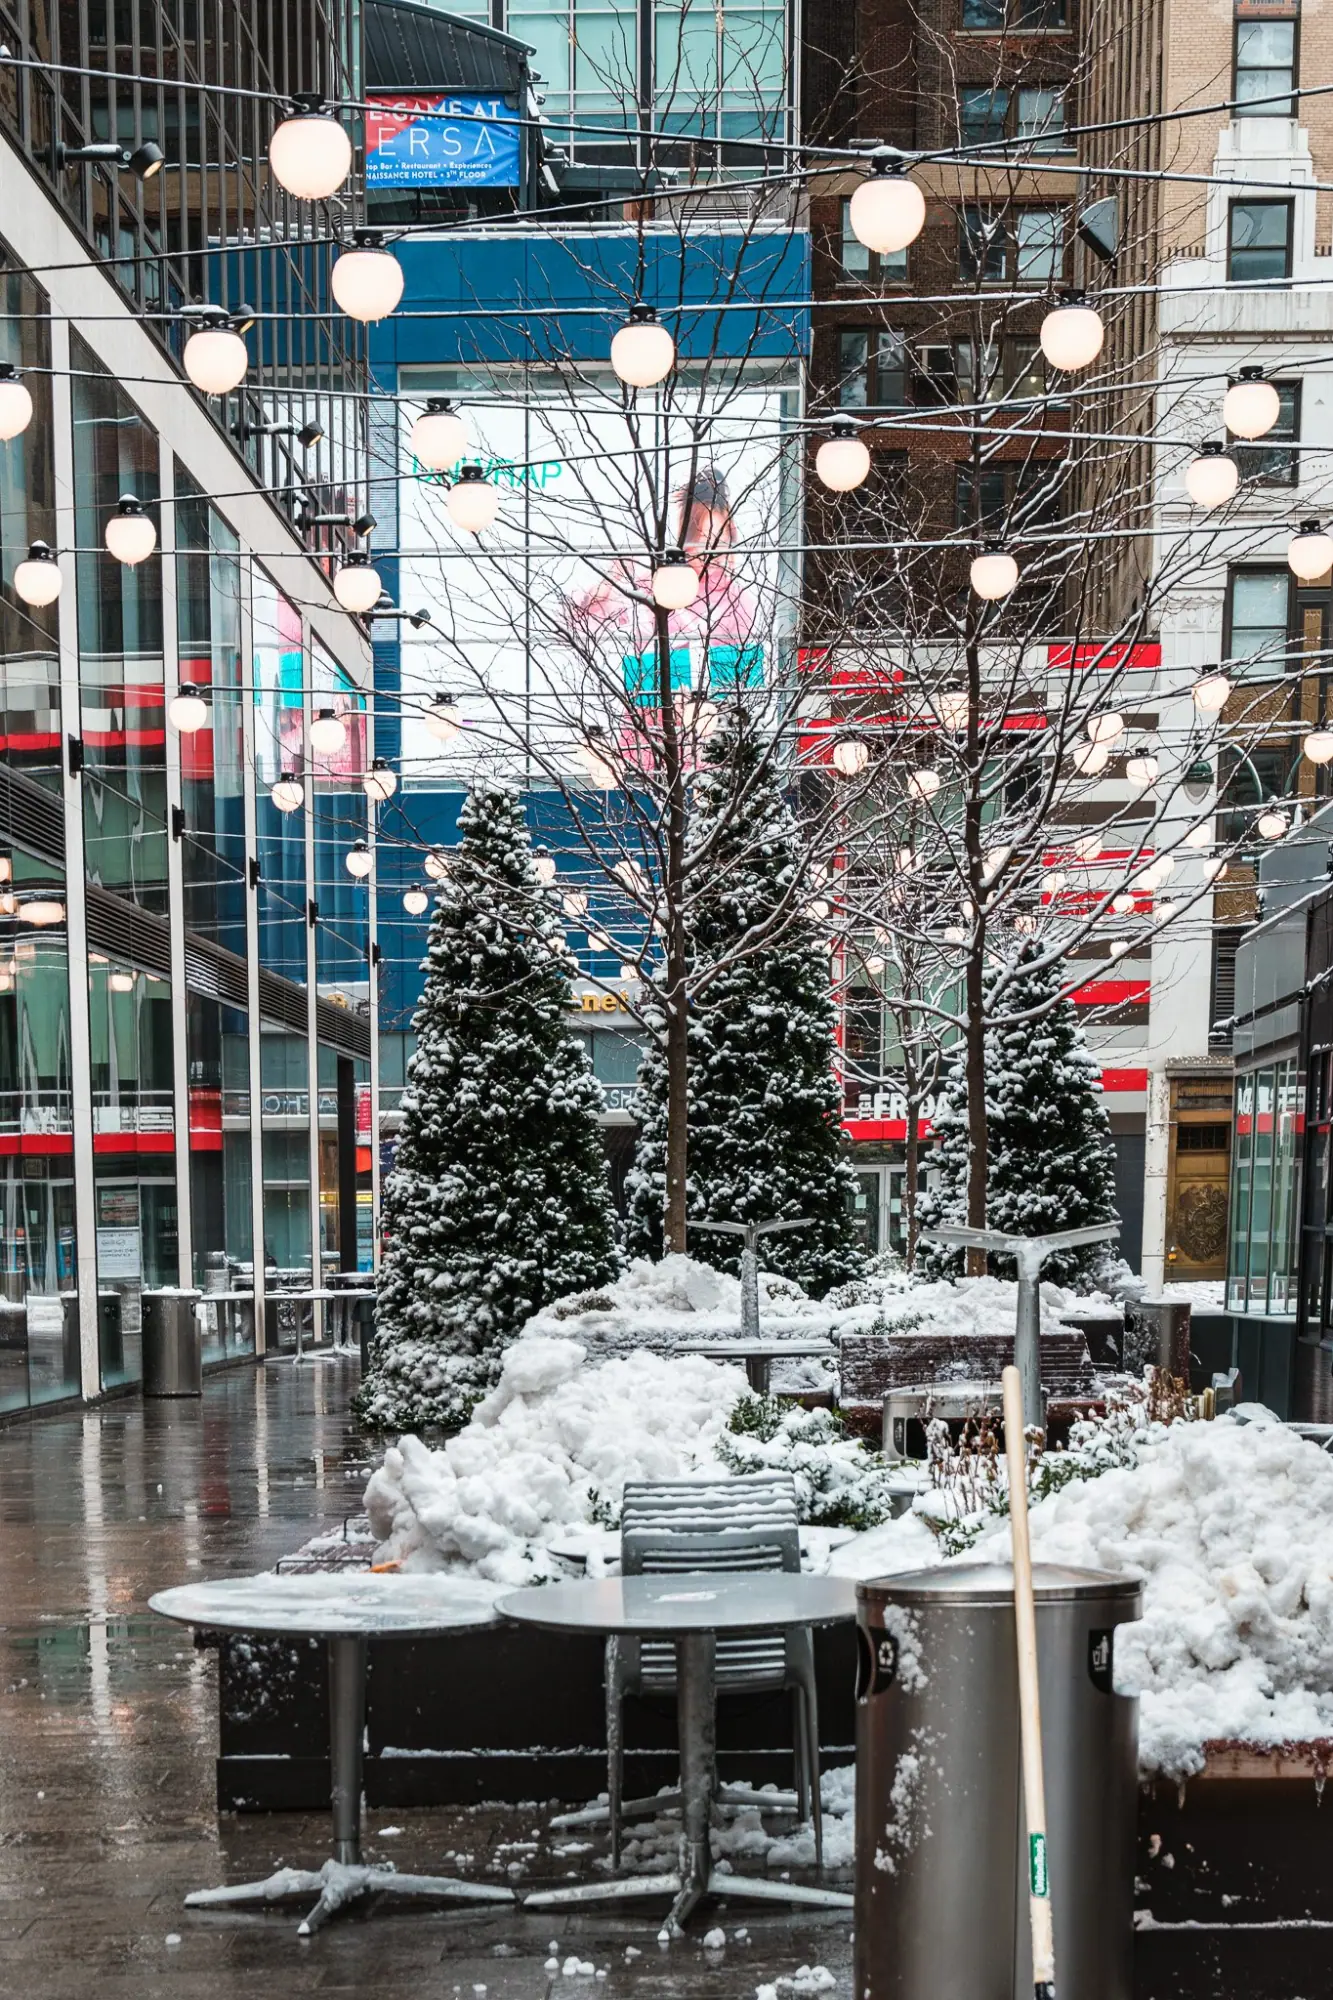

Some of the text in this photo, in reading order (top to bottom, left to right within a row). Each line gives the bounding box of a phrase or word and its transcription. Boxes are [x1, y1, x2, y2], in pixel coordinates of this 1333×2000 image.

[473, 100, 501, 119] AT
[380, 162, 393, 170] Bar
[401, 162, 441, 170] Restaurant
[449, 161, 492, 171] Experiences
[411, 171, 438, 179] HOTEL
[459, 171, 486, 179] FLOOR
[571, 988, 630, 1012] net
